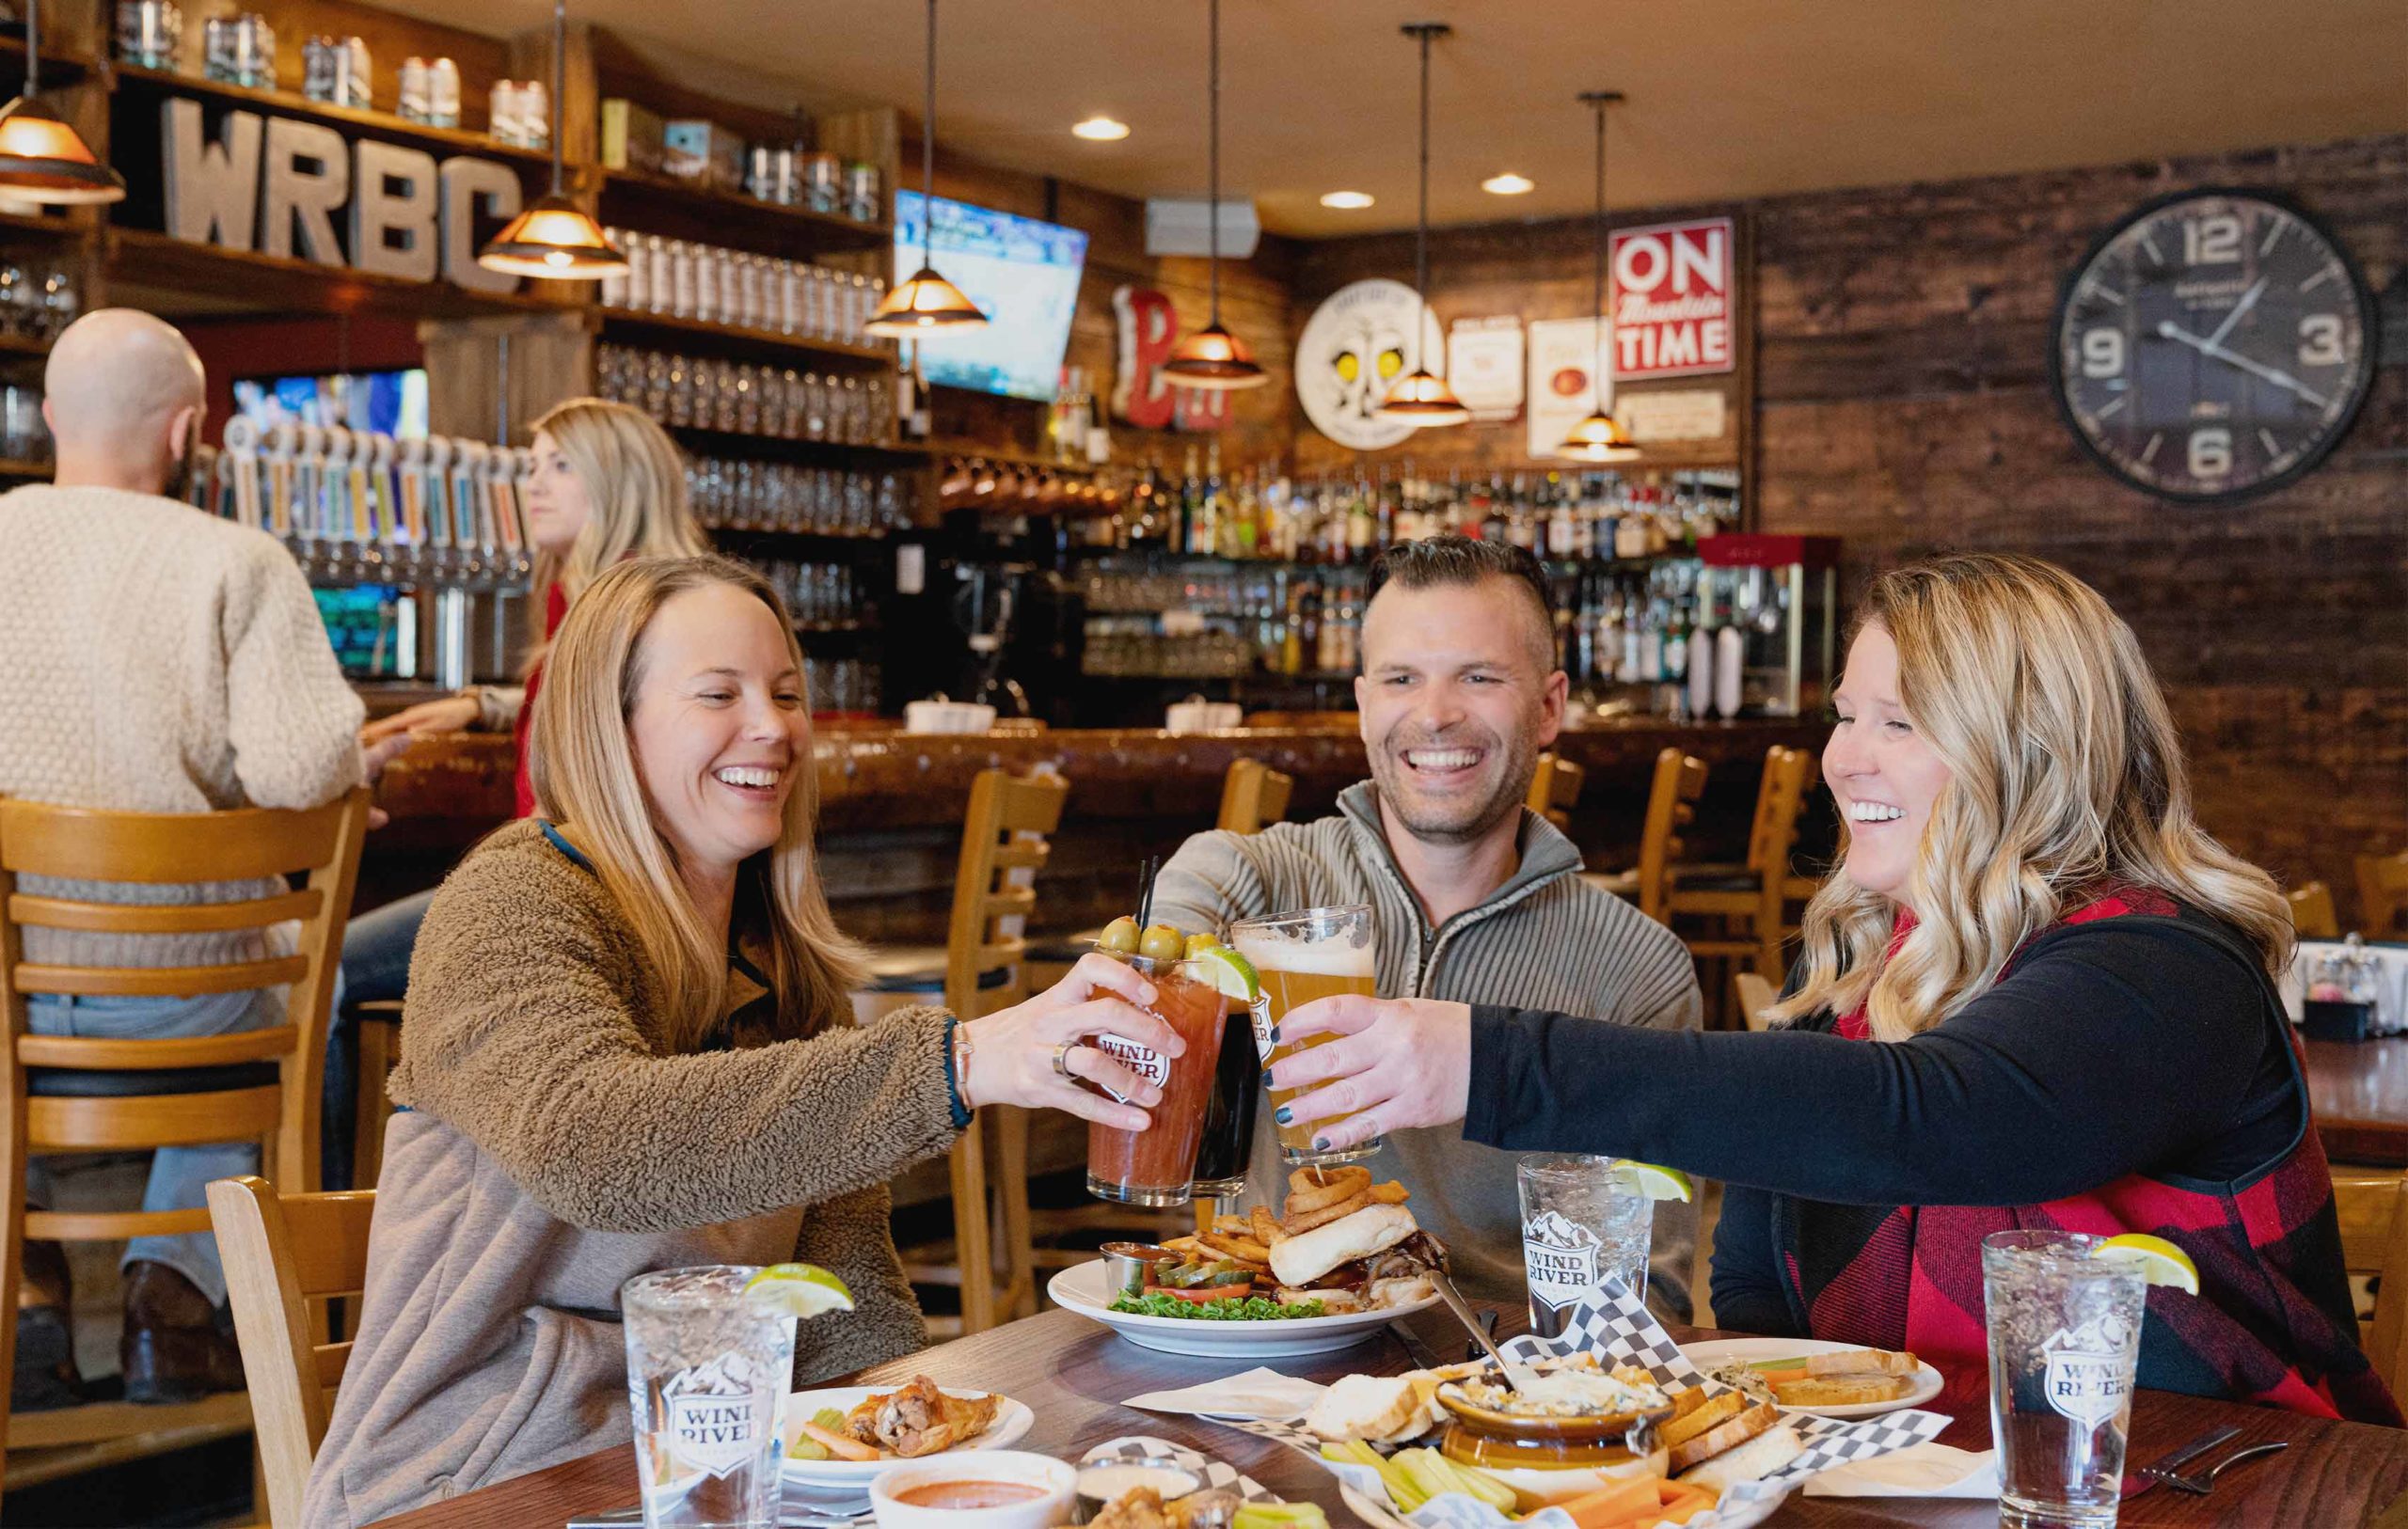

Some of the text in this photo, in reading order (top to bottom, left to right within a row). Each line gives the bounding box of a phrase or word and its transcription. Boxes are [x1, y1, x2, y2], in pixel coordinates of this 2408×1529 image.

[162, 97, 521, 293] WRBC
[2183, 216, 2242, 265] 12
[1615, 229, 1723, 294] ON
[1617, 292, 1724, 324] Mountain
[1617, 320, 1726, 370] TIME
[2083, 328, 2124, 378] 9
[2298, 313, 2345, 366] 3
[2187, 427, 2233, 479] 6
[1102, 1039, 1157, 1063] WIND
[1113, 1058, 1160, 1080] VER
[1529, 1250, 1583, 1270] WIND
[1529, 1264, 1588, 1286] RIVER
[2056, 1380, 2126, 1396] RIER
[680, 1423, 752, 1444] RIVE
